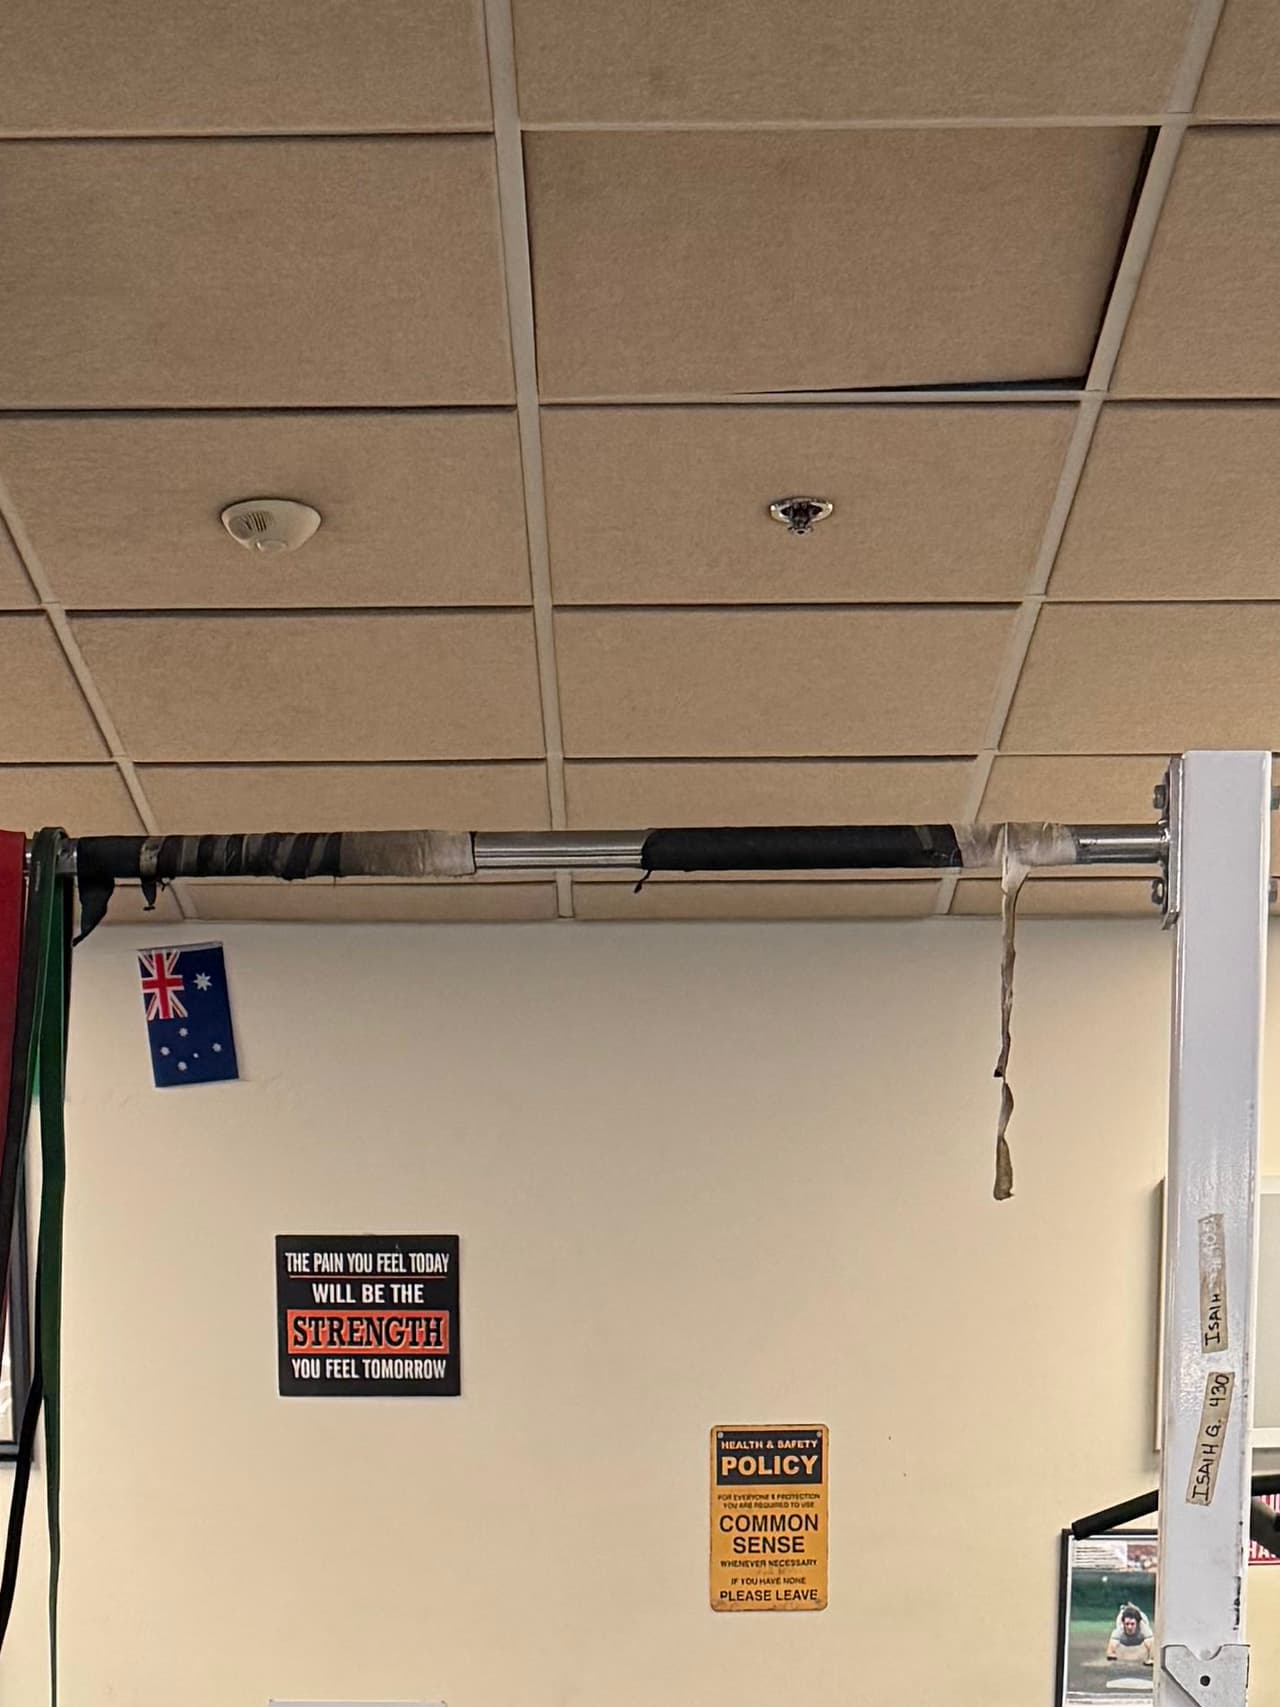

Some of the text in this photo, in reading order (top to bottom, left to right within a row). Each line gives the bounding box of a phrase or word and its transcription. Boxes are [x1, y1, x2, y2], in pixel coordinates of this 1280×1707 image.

[284, 1252, 450, 1273] THE PAIN YOU FEEL TODAY
[312, 1283, 425, 1304] WILL BE THE
[292, 1315, 445, 1350] STRENGTH
[291, 1358, 447, 1380] YOU FEEL TOMORROW
[1208, 1373, 1230, 1407] 430
[721, 1439, 818, 1450] HEALTH & SAFETY
[721, 1455, 818, 1476] POLICY
[719, 1514, 818, 1533] COMMON
[733, 1536, 805, 1554] SENSE
[720, 1559, 817, 1568] WHENEVER NECESSARY
[741, 1577, 758, 1585] YOU
[759, 1577, 781, 1585] HAVE
[720, 1589, 818, 1601] PLEASE LEAVE
